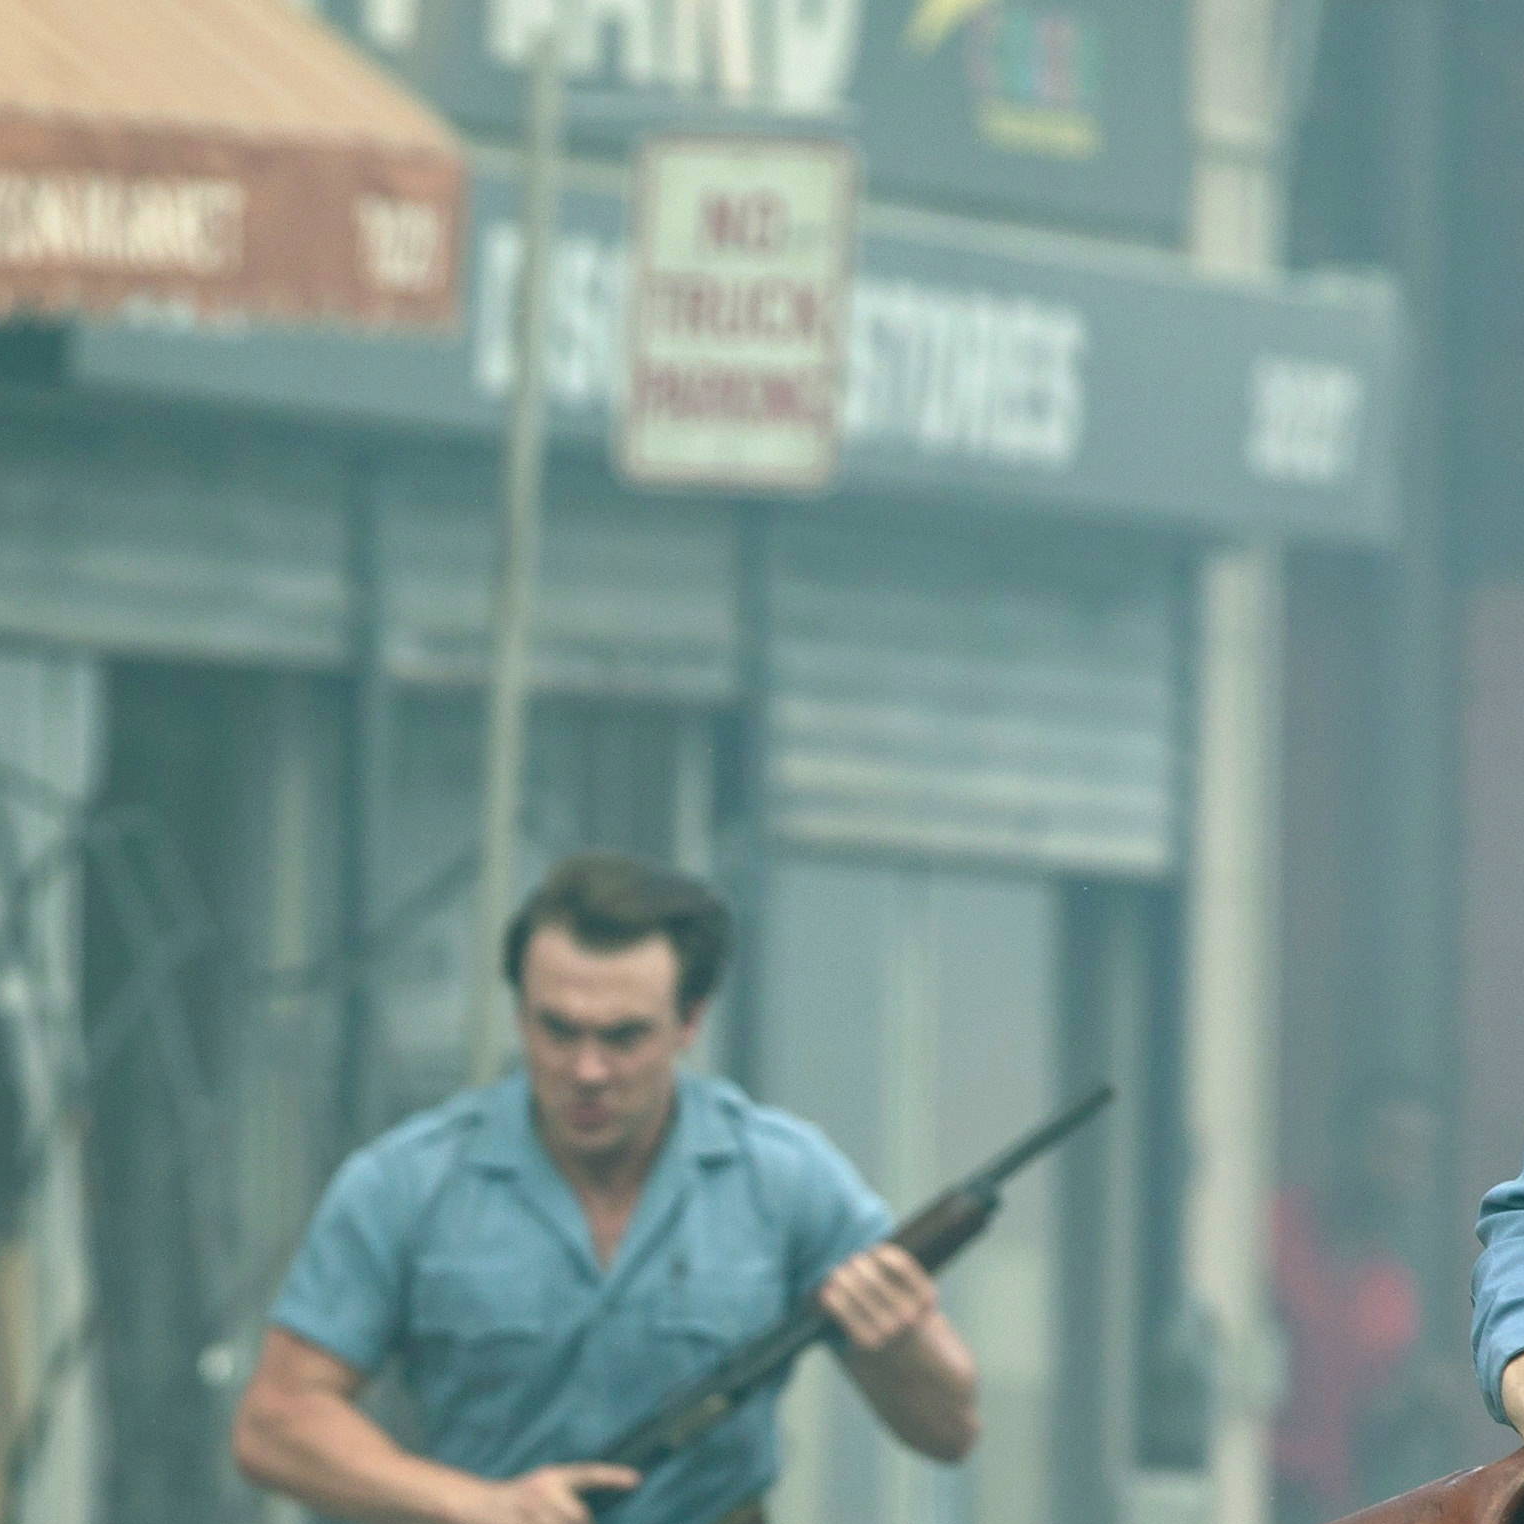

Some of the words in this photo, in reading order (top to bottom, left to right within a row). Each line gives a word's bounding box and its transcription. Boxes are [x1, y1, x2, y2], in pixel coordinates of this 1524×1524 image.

[698, 190, 787, 254] NO
[642, 272, 828, 342] TRUCK
[842, 280, 1084, 464] STORES
